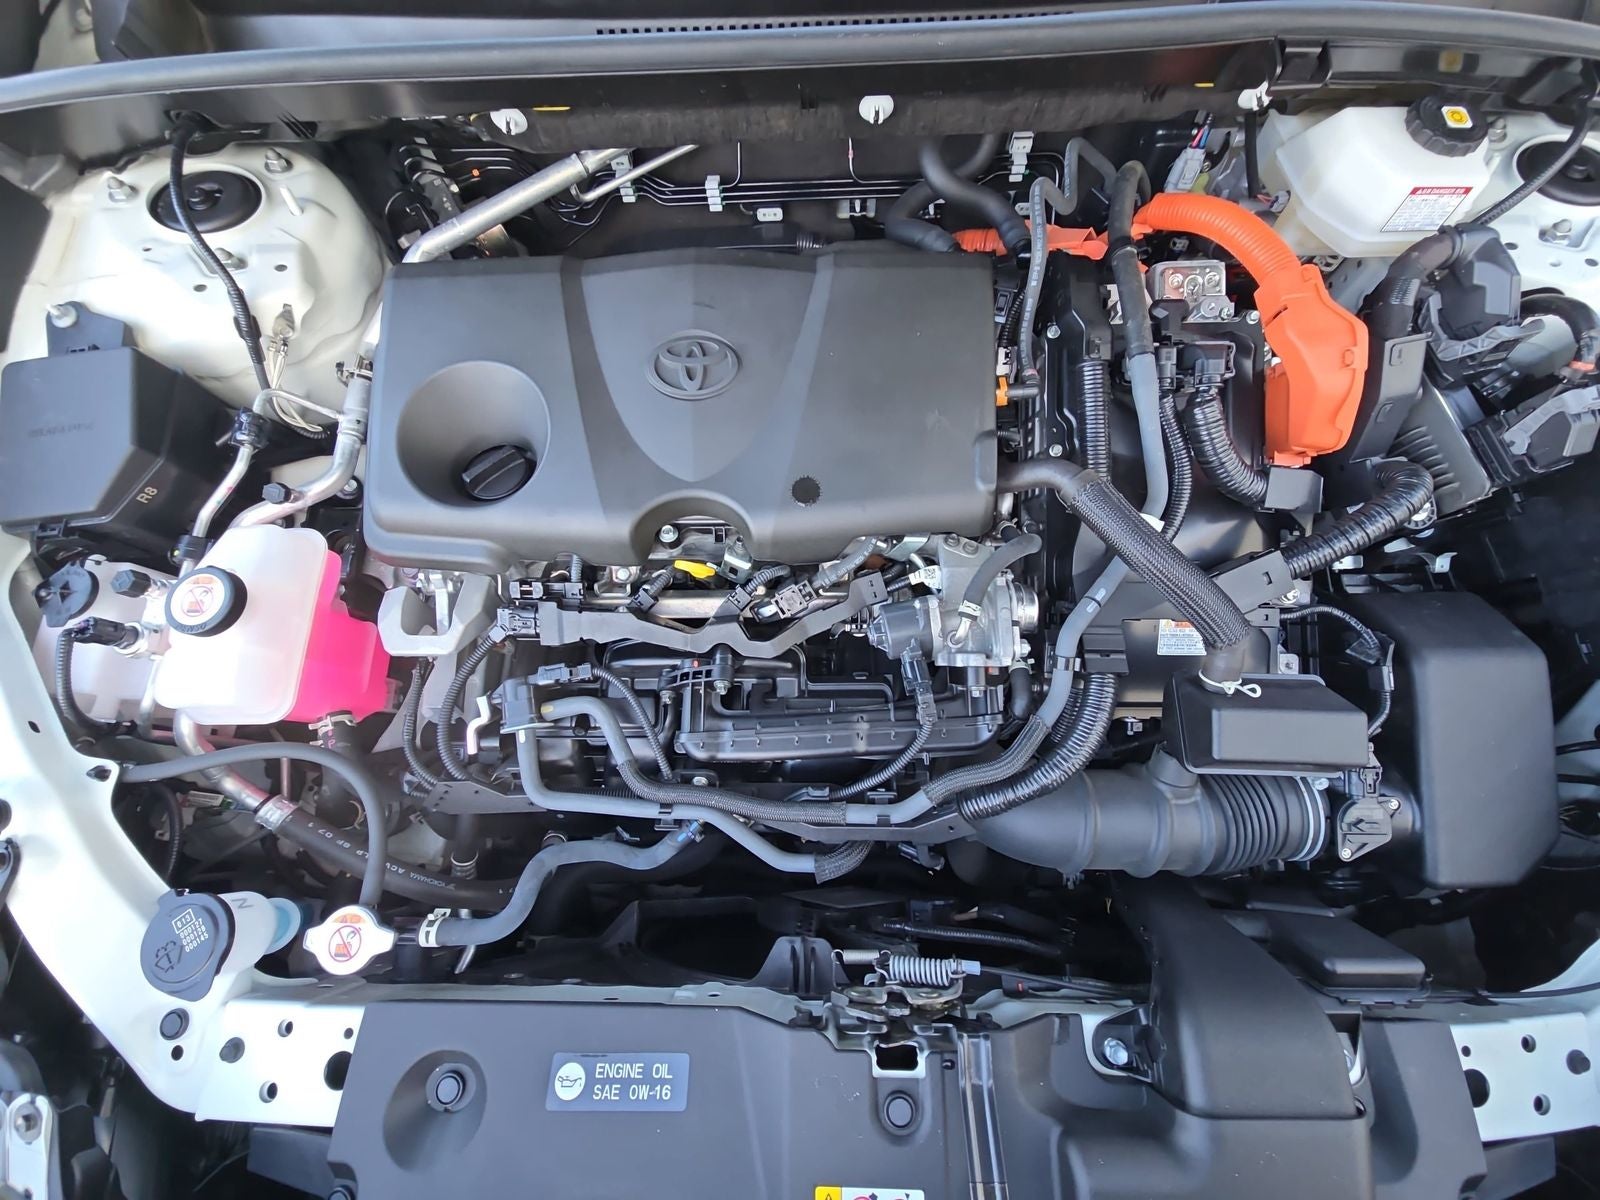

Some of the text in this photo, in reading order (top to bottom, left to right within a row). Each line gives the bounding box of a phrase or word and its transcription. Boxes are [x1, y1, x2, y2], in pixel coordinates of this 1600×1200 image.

[136, 486, 158, 503] R8
[180, 918, 203, 938] 000127
[184, 932, 209, 952] 000145
[595, 1063, 673, 1079] ENGINE OIL
[592, 1084, 671, 1100] SAE 0W-16
